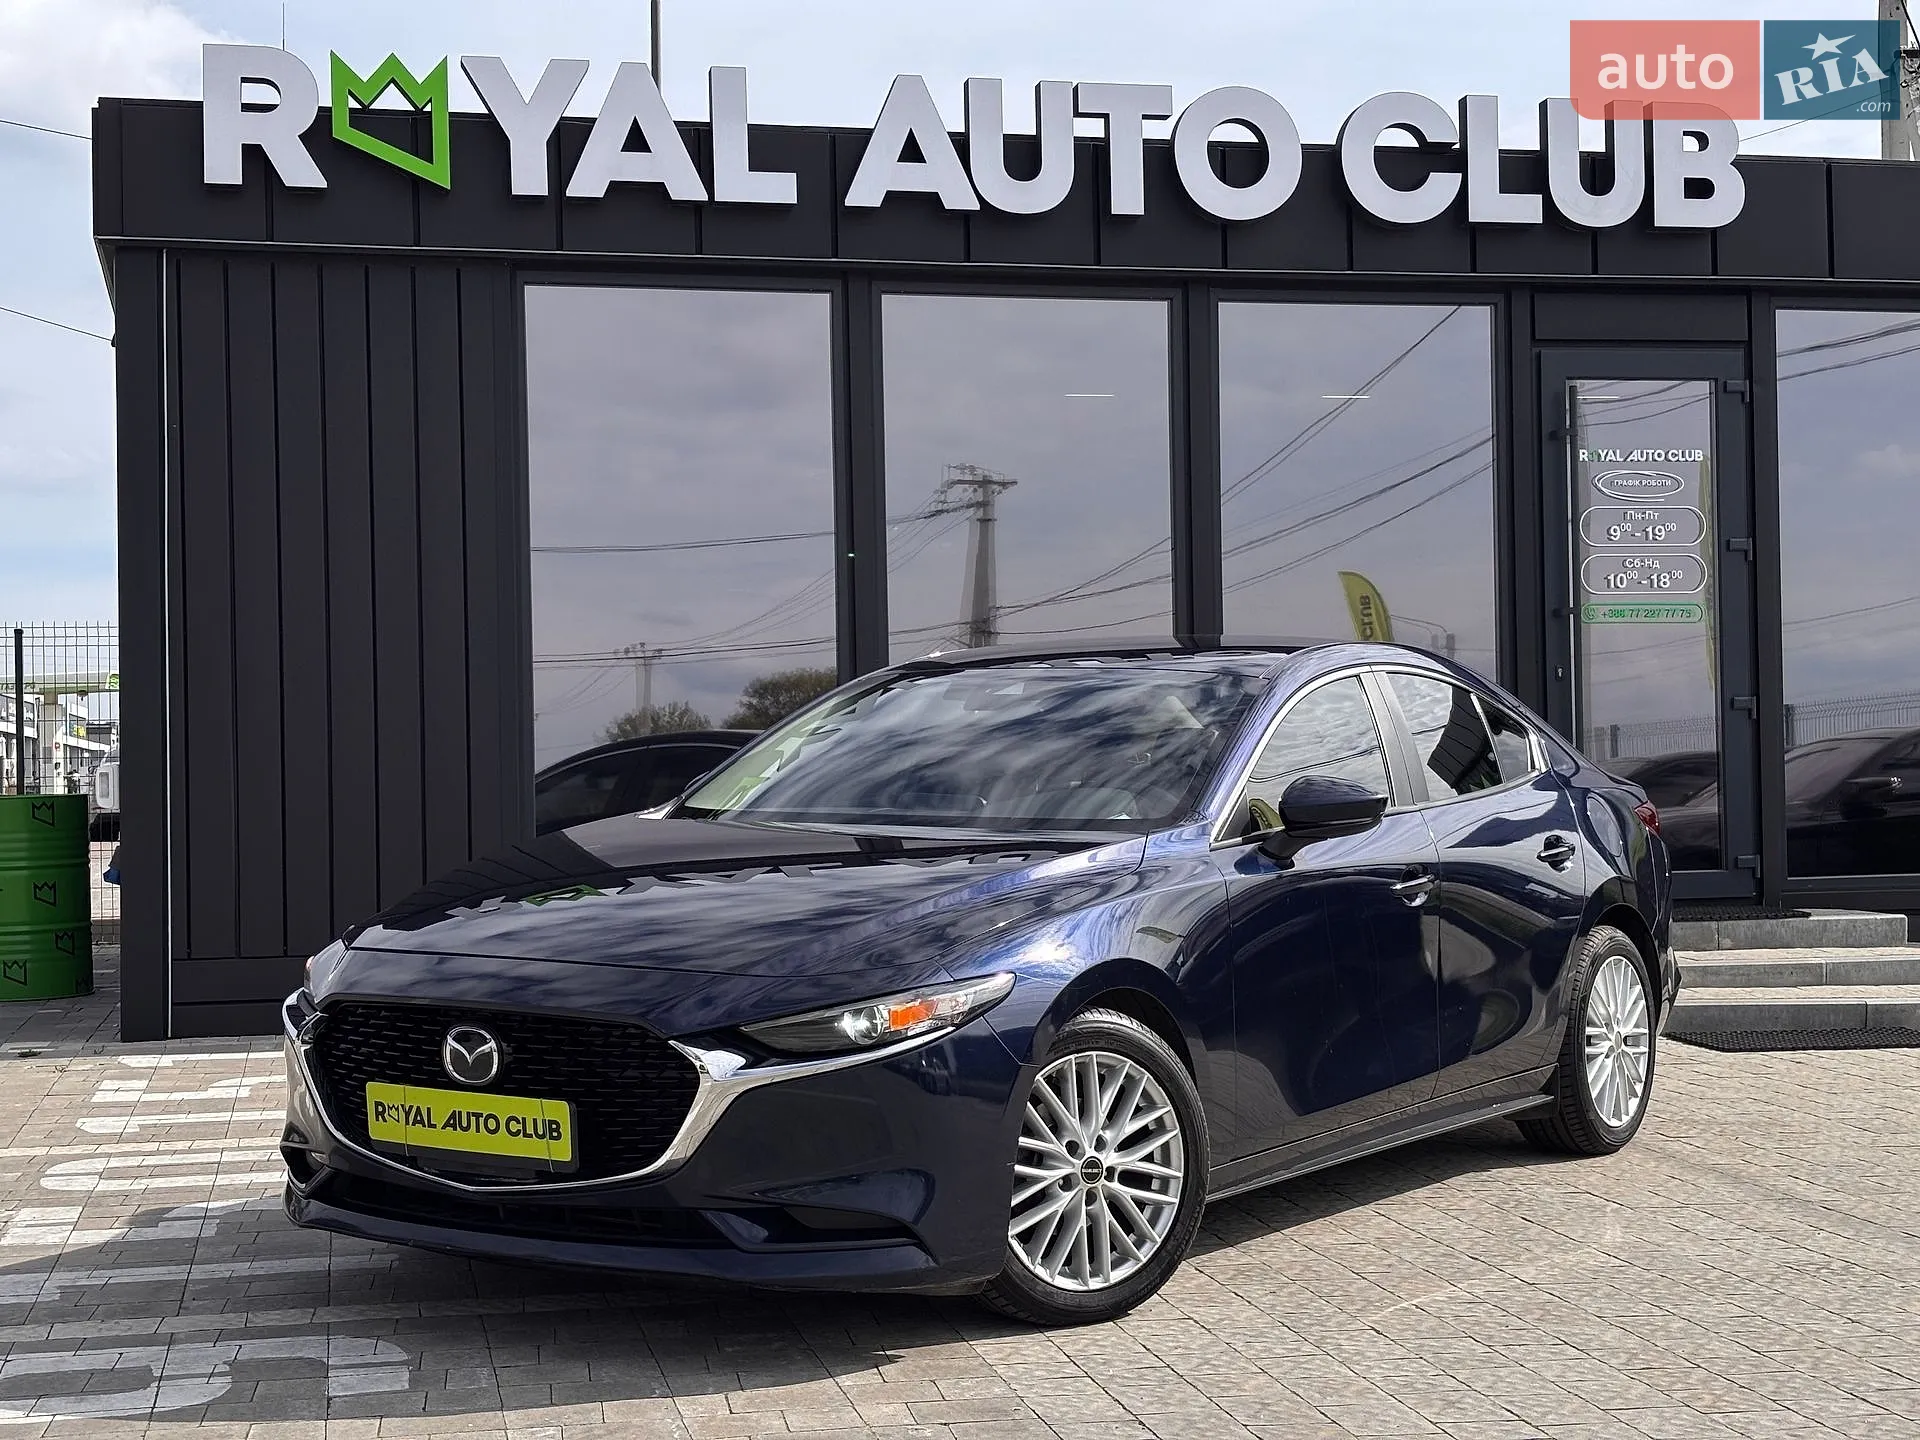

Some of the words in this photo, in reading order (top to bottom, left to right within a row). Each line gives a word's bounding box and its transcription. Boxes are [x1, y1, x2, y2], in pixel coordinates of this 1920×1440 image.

[845, 74, 1303, 220] AUTO
[1338, 91, 1746, 229] CLUB
[1626, 449, 1666, 461] AUTO
[1668, 449, 1704, 461] CLUB
[1642, 479, 1671, 487] РОБОТИ
[1627, 510, 1659, 520] Пн-Пт
[1625, 558, 1660, 569] Сб-Нд
[441, 1109, 502, 1135] AUTO
[504, 1116, 563, 1142] CLUB
